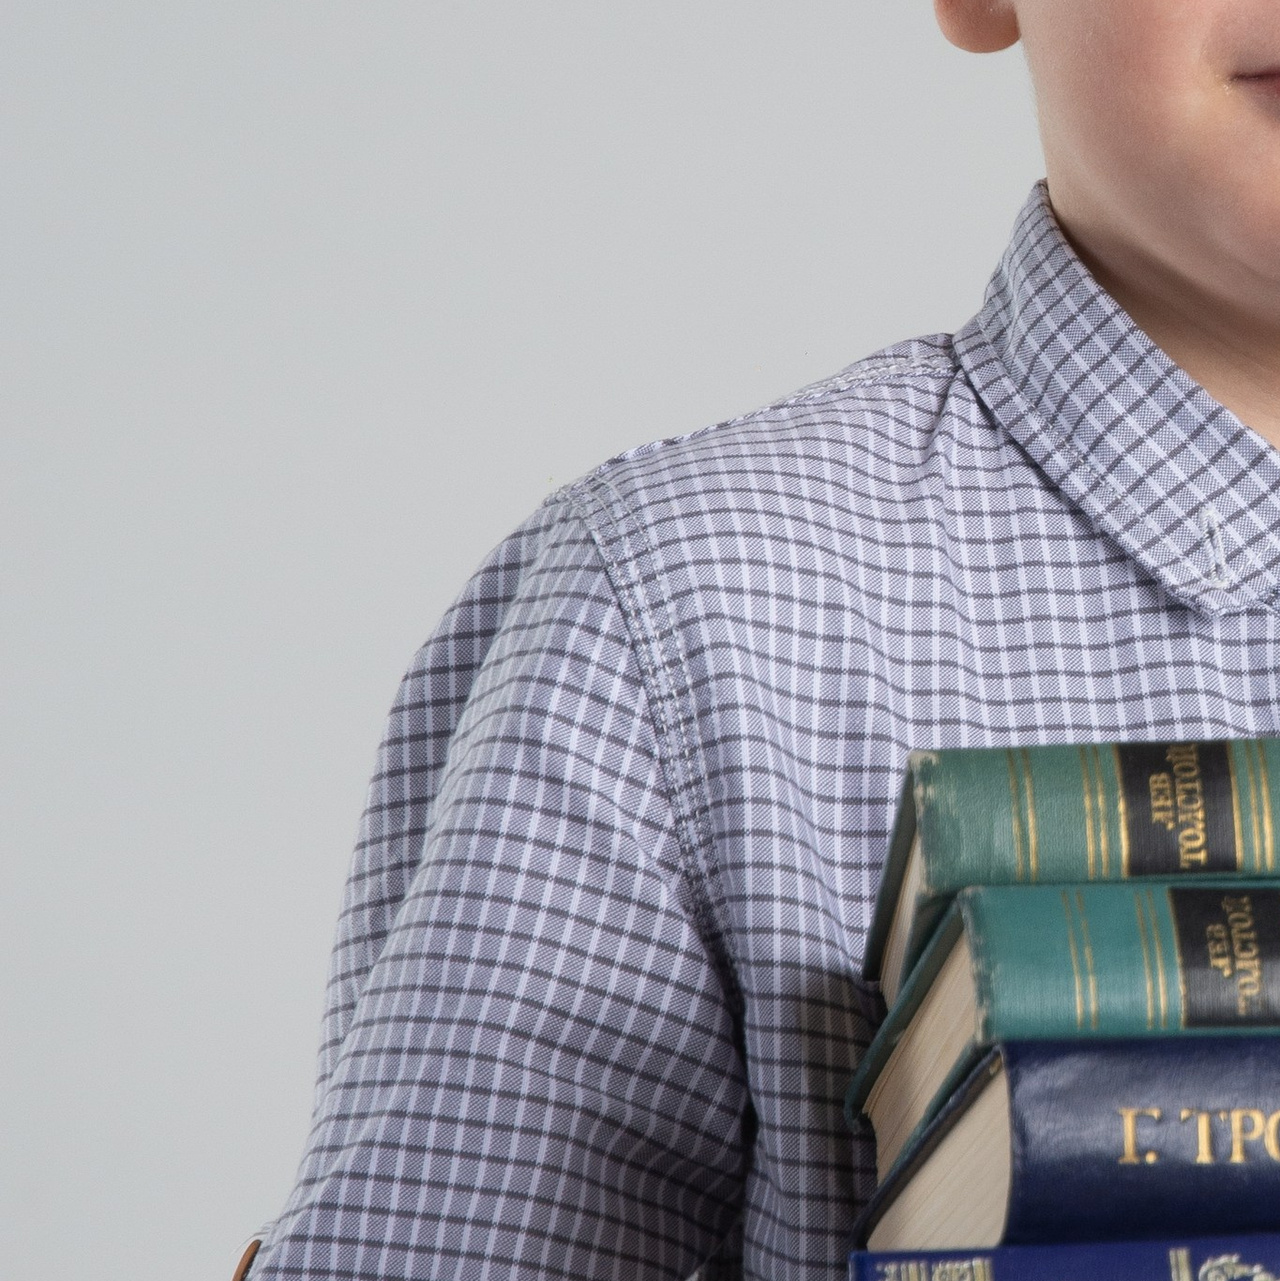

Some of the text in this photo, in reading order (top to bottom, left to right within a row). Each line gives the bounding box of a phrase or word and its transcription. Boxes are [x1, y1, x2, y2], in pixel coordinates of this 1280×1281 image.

[1148, 772, 1176, 831] ЛЕВ
[1165, 743, 1206, 869] ТОЛСТОЙ
[1118, 1107, 1160, 1164] Г.
